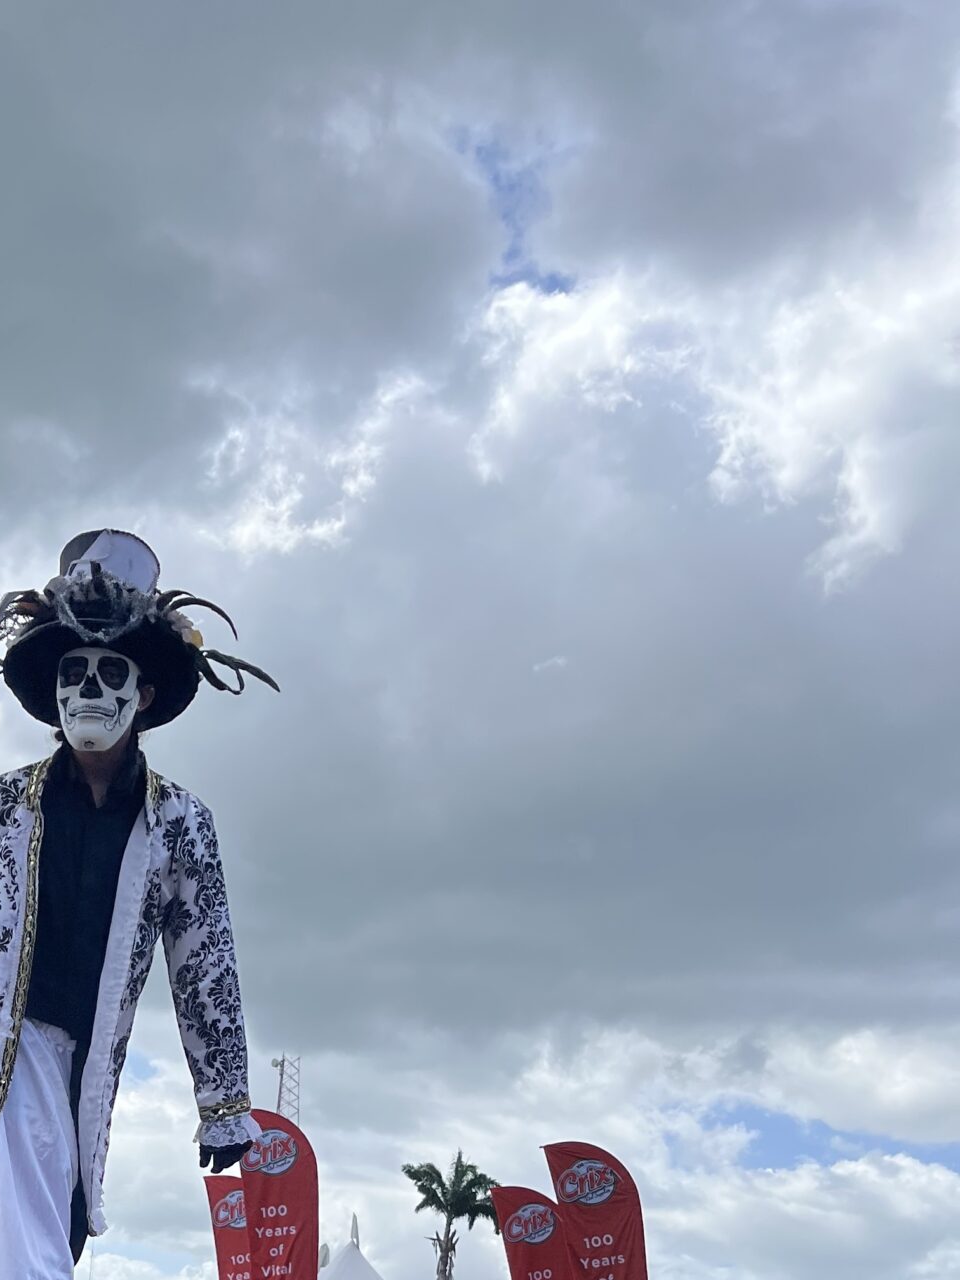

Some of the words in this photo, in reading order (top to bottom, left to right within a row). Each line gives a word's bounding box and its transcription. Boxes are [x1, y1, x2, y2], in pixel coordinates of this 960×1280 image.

[241, 1136, 297, 1172] Crix
[557, 1167, 614, 1202] Crix
[212, 1197, 245, 1227] Cri
[261, 1205, 288, 1218] 100
[255, 1226, 297, 1238] Years
[504, 1209, 554, 1243] Crix
[583, 1234, 614, 1249] 100
[269, 1244, 285, 1257] of
[580, 1254, 625, 1270] Years
[261, 1263, 292, 1278] Vital
